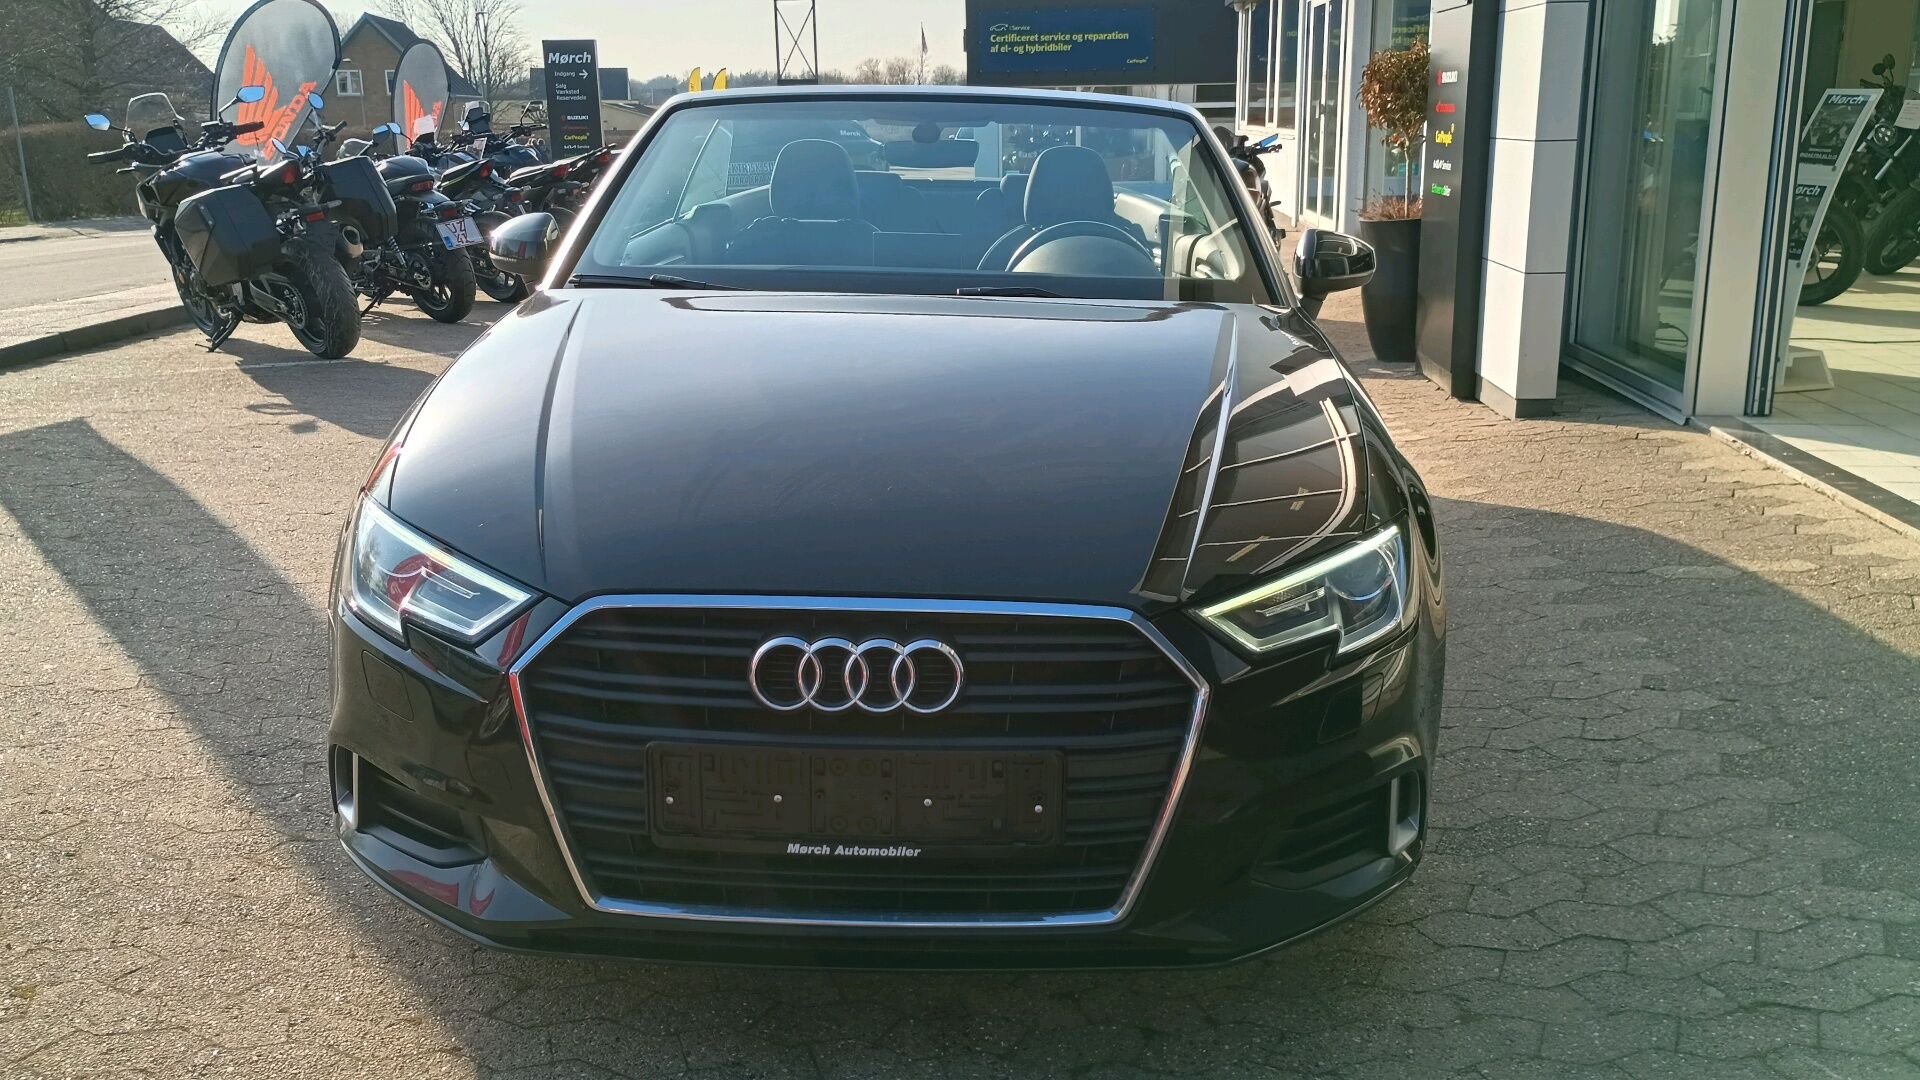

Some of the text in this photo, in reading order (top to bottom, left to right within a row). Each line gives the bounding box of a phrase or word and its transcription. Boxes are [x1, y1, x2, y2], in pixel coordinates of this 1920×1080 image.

[990, 31, 1129, 42] Certificeret service og reparation
[990, 43, 1072, 54] af el- og hybridbiler
[548, 52, 592, 64] Mørch
[1828, 94, 1864, 105] Mørch
[1795, 185, 1820, 196] ørch
[787, 843, 921, 857] Mørch Automobiler
